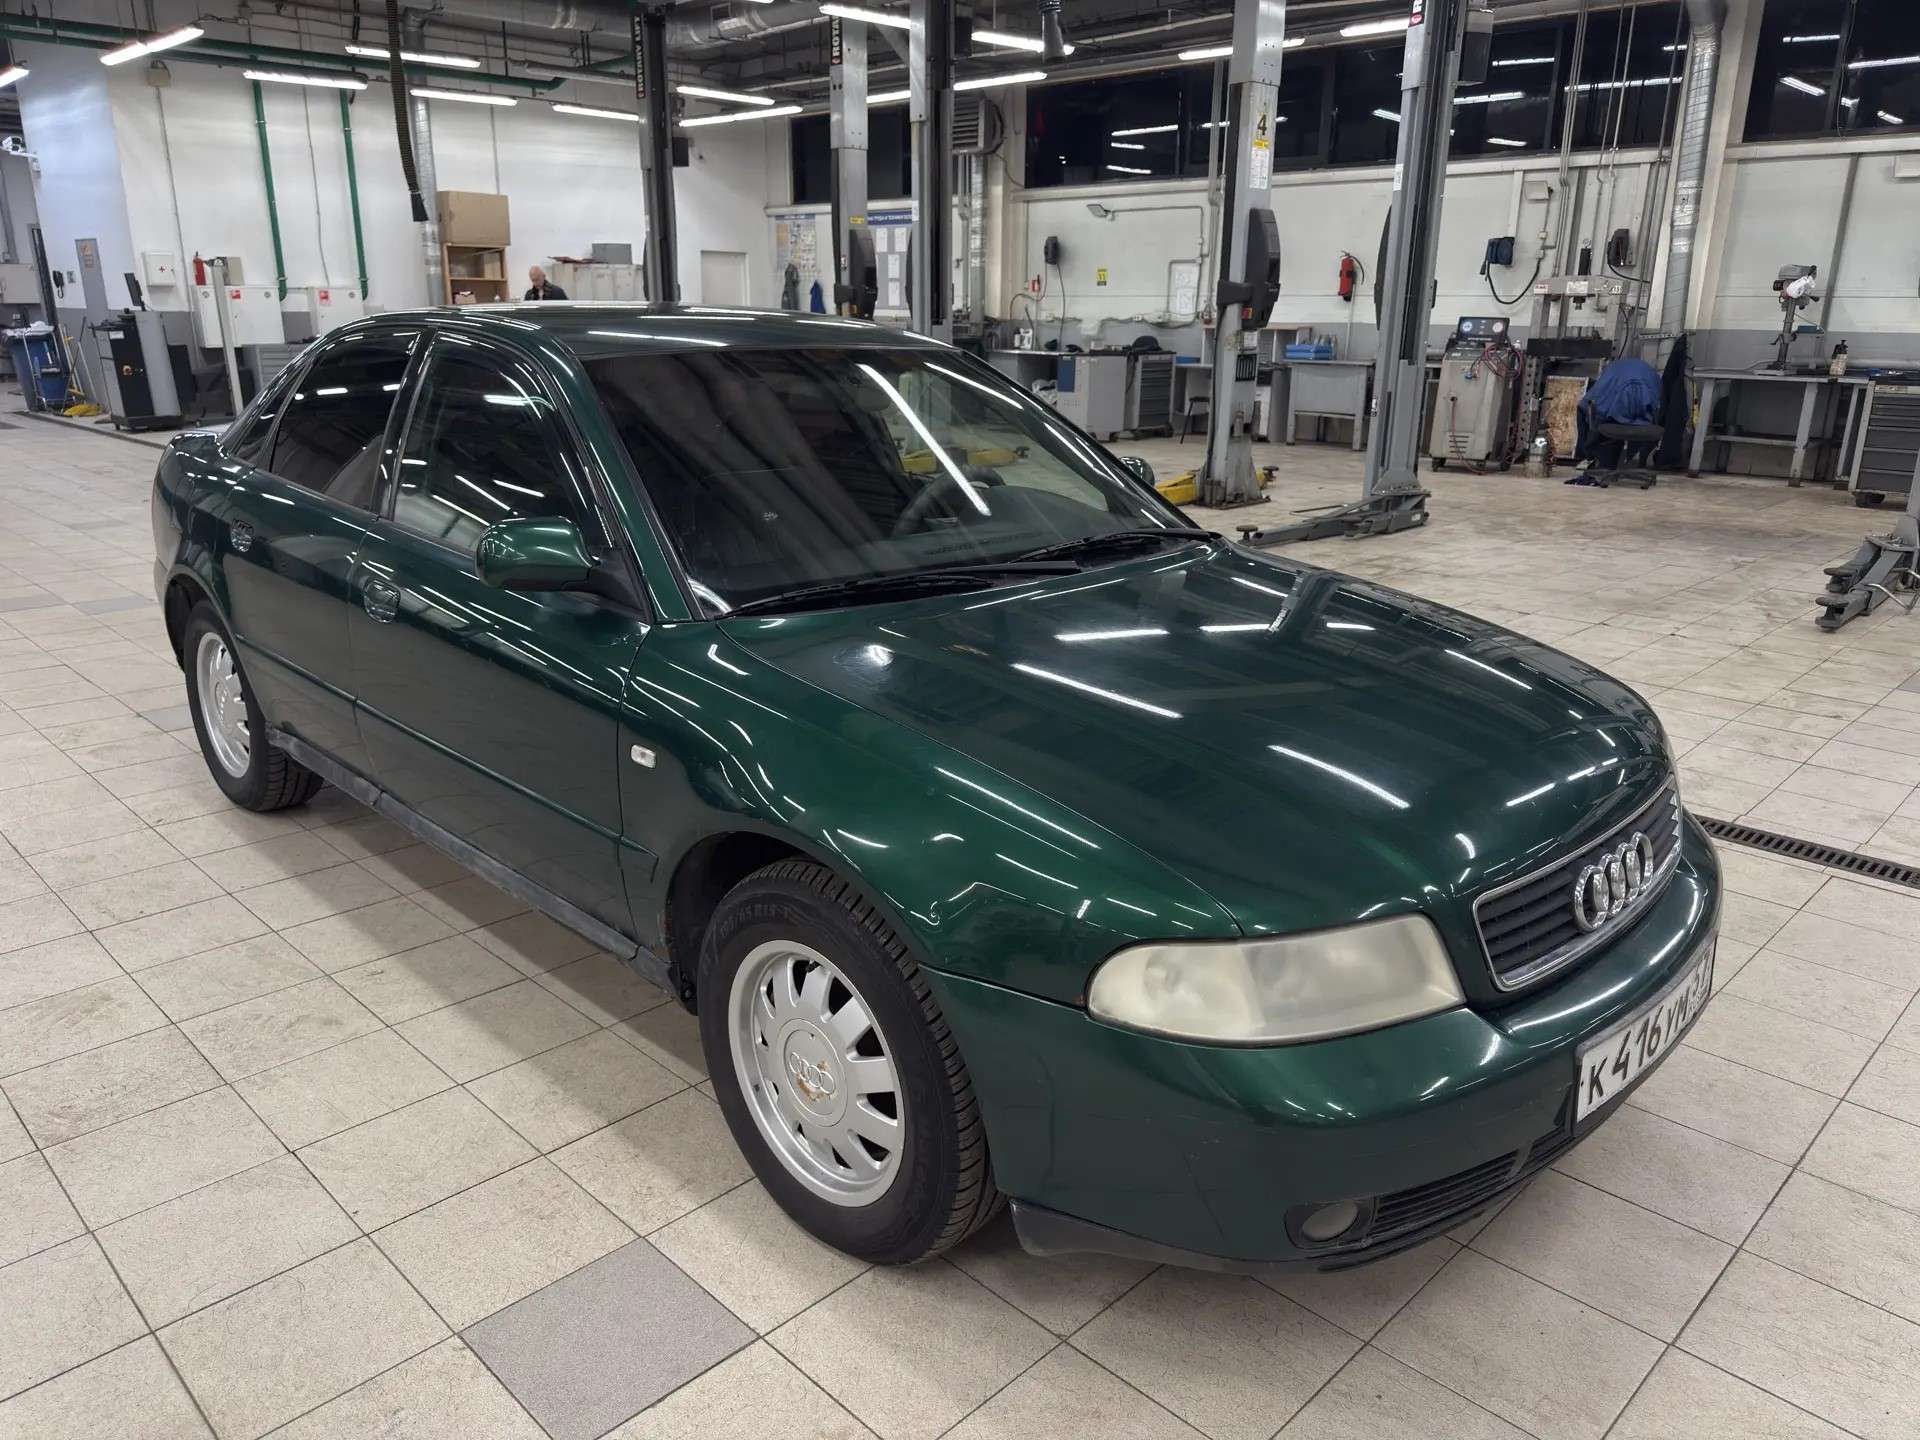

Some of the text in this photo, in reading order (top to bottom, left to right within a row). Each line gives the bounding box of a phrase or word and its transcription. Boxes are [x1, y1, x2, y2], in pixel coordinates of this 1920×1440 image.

[633, 15, 645, 91] ROTARY LIFT
[1257, 114, 1267, 135] 4
